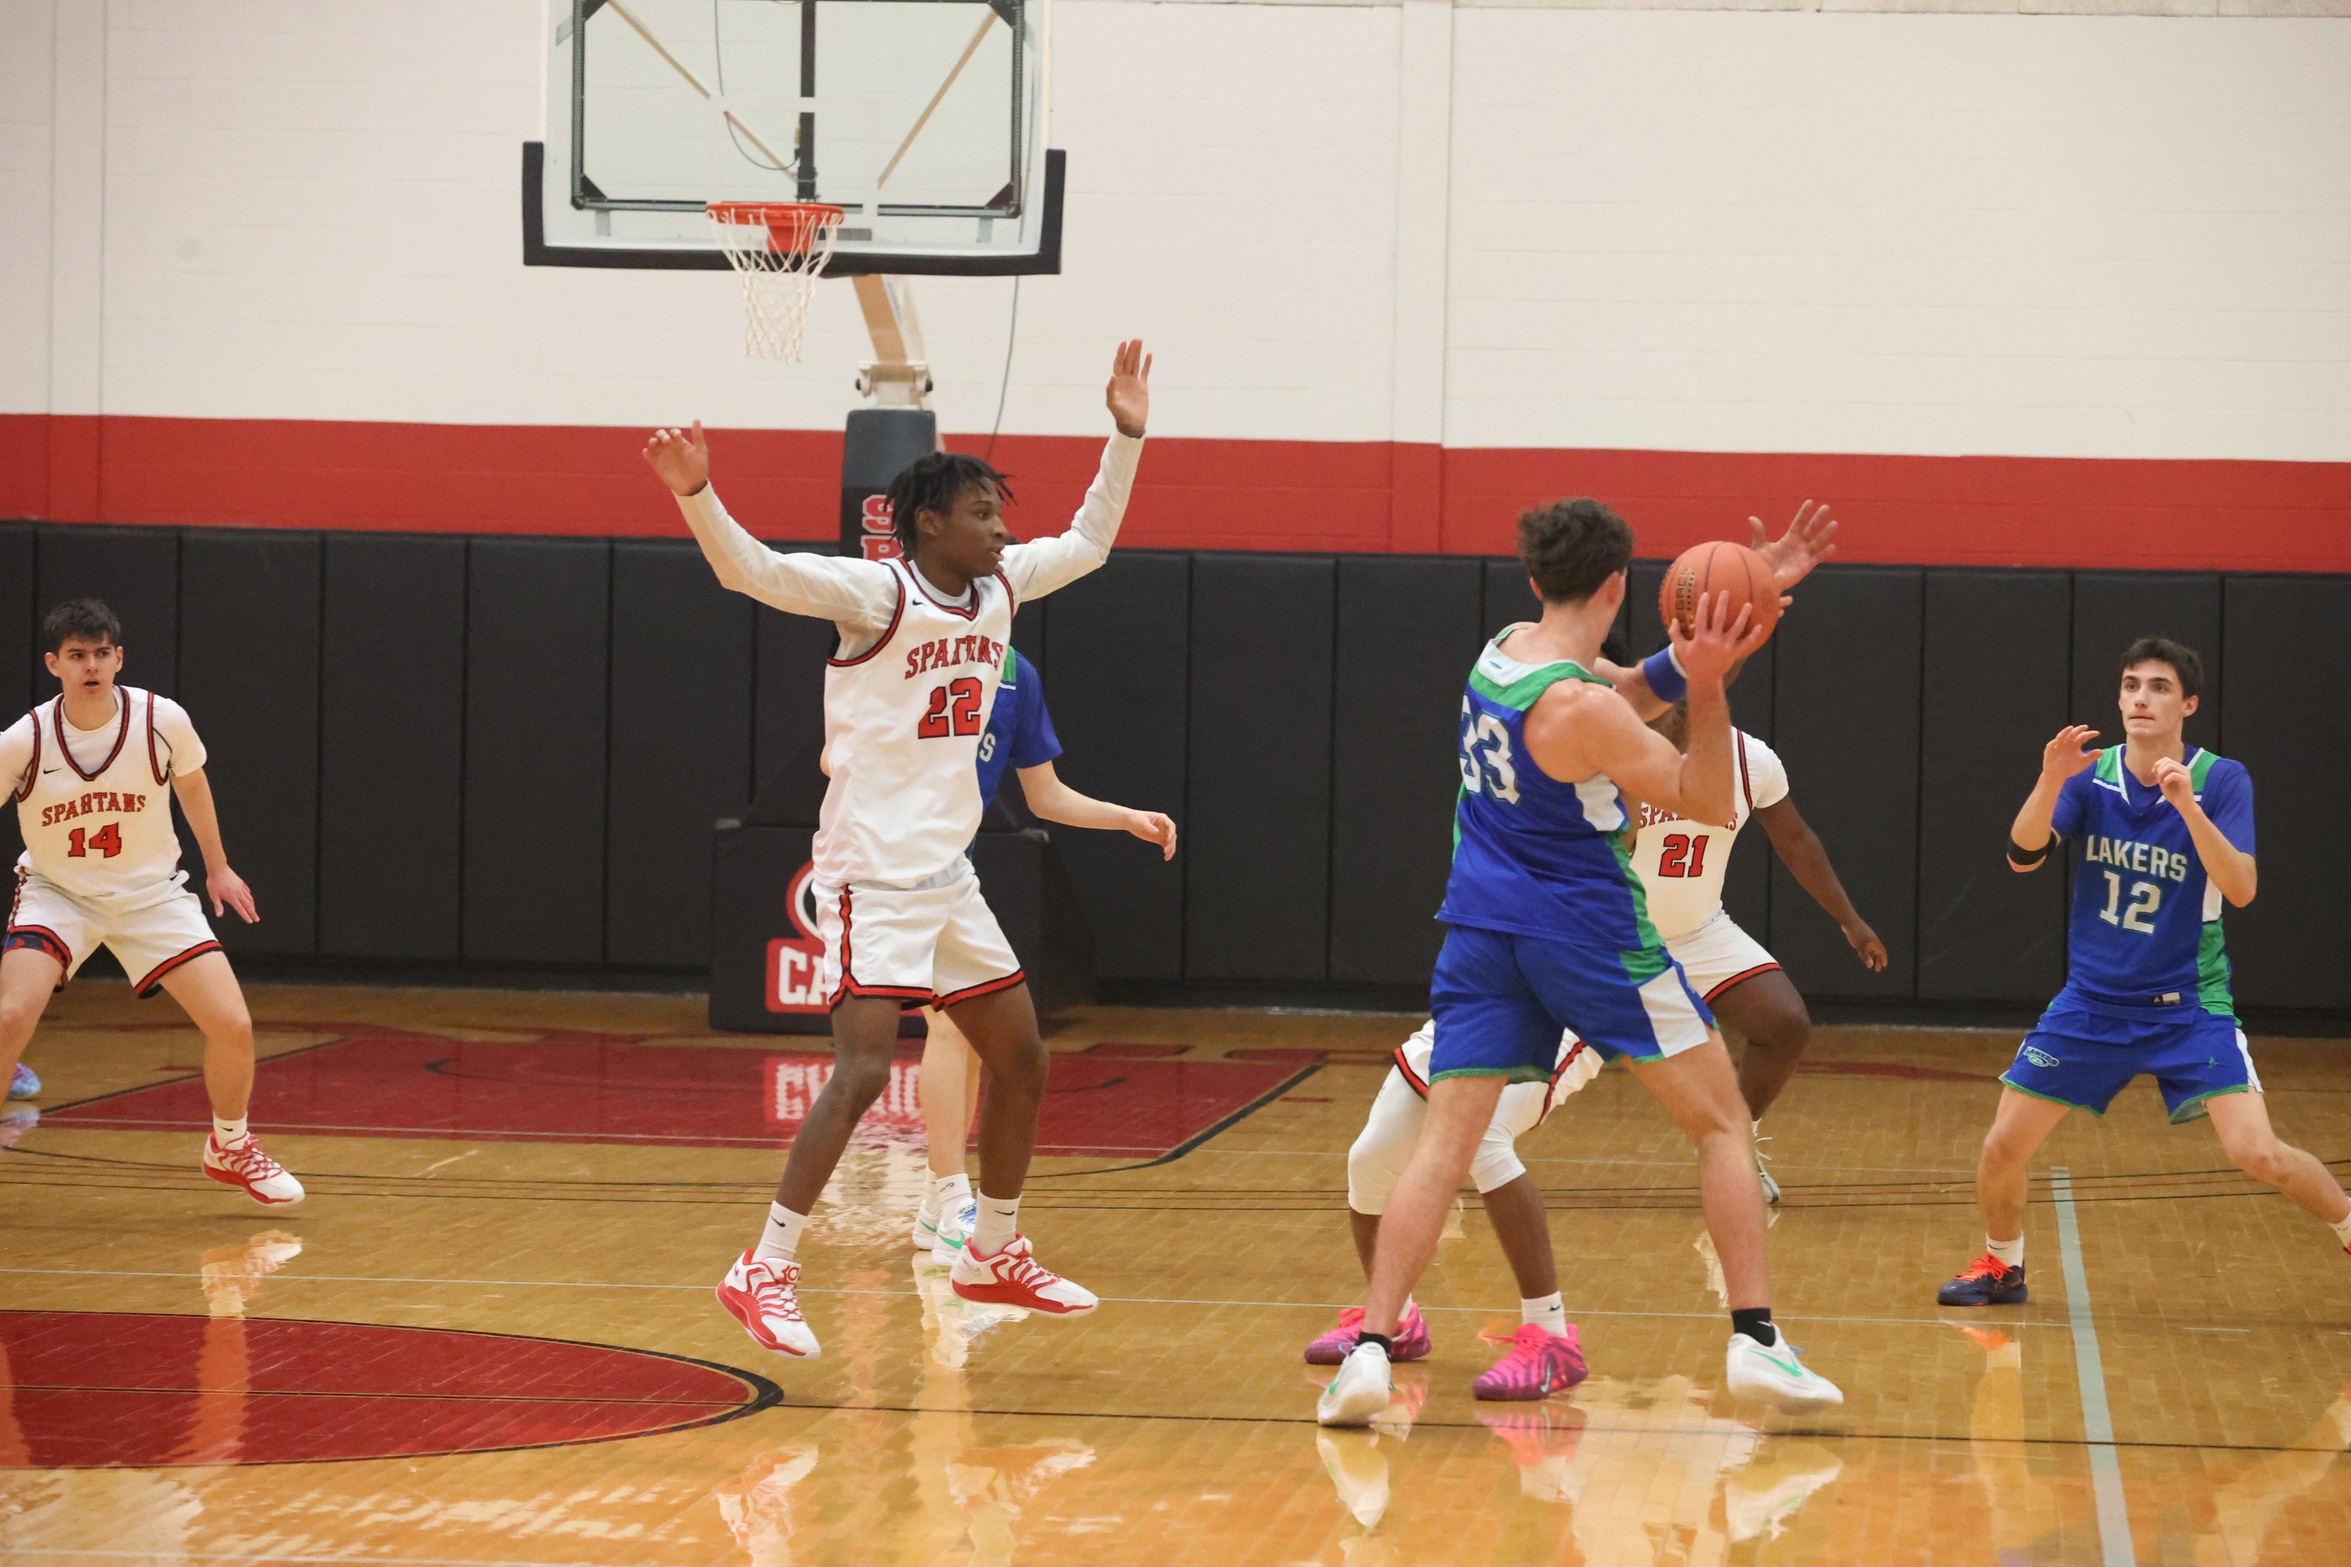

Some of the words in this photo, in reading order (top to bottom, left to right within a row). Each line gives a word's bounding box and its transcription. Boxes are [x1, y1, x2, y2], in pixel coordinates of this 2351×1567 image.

[917, 676, 982, 739] 22
[1459, 694, 1521, 805] 33
[42, 791, 146, 828] SPARTANS
[67, 821, 122, 859] 14
[1658, 833, 1710, 878] 21
[2085, 834, 2189, 883] LAKERS
[2098, 870, 2163, 936] 12
